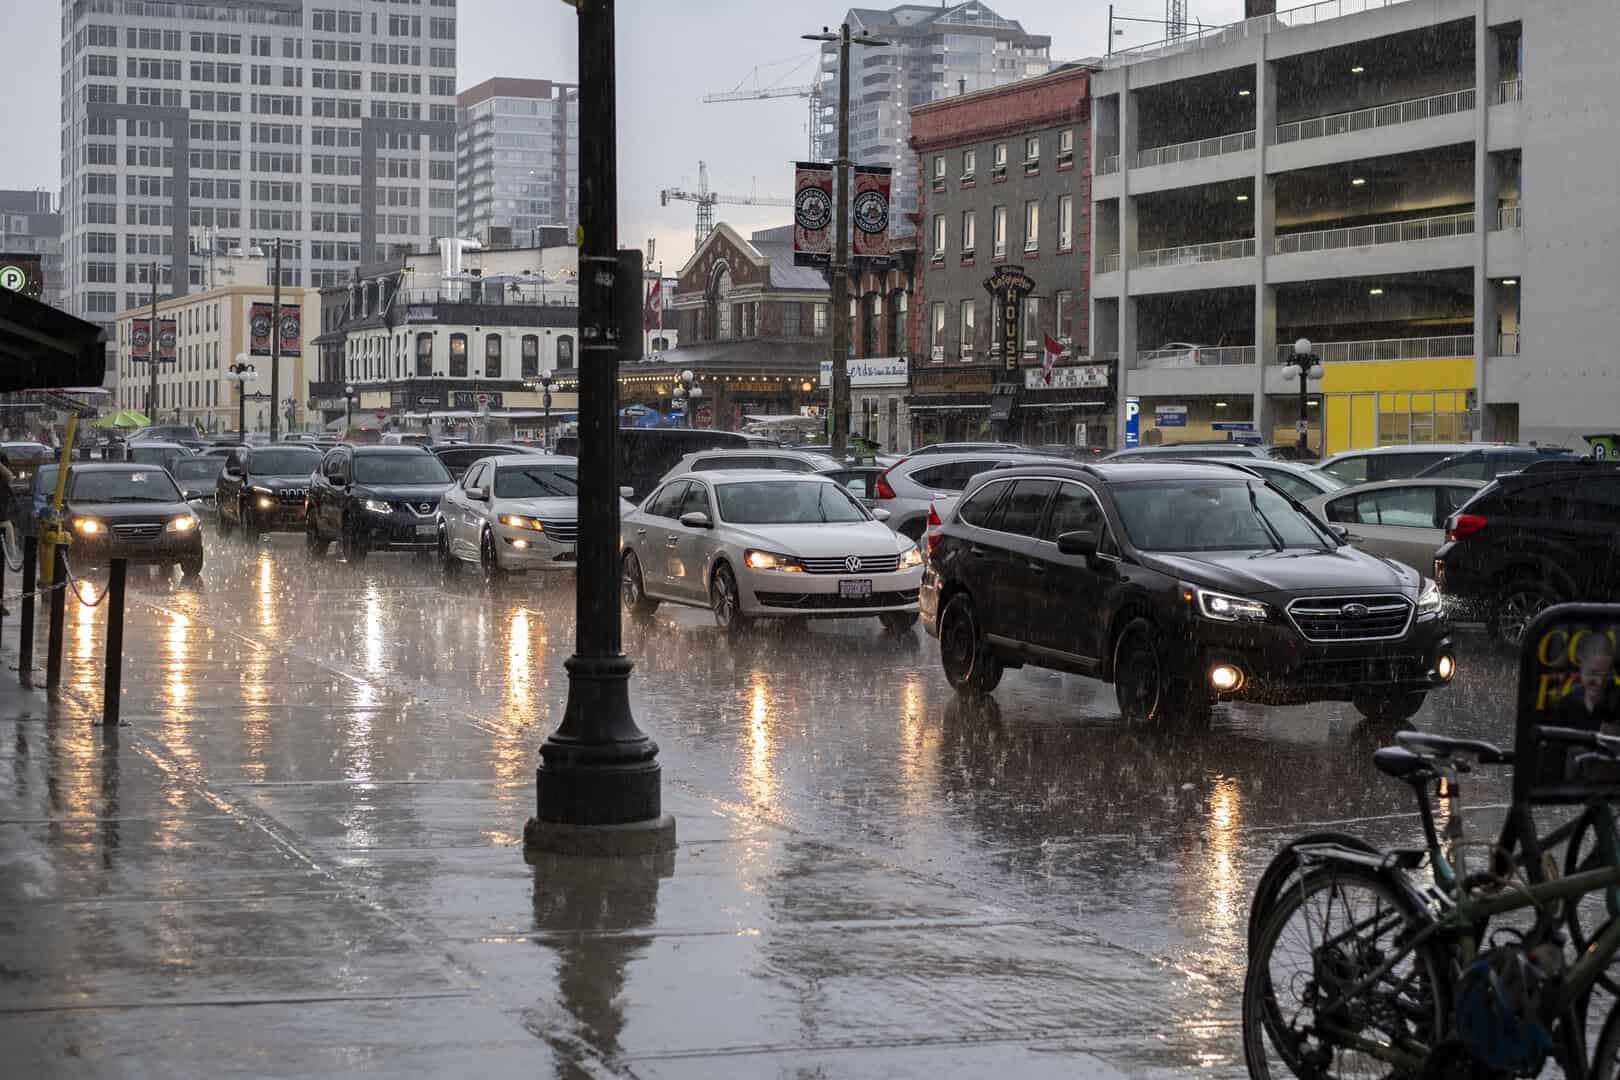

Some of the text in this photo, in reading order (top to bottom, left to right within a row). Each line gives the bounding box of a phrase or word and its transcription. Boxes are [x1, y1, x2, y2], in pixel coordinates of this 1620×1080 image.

[8, 273, 17, 287] P
[1006, 289, 1017, 370] HOUSE
[1126, 402, 1140, 421] P
